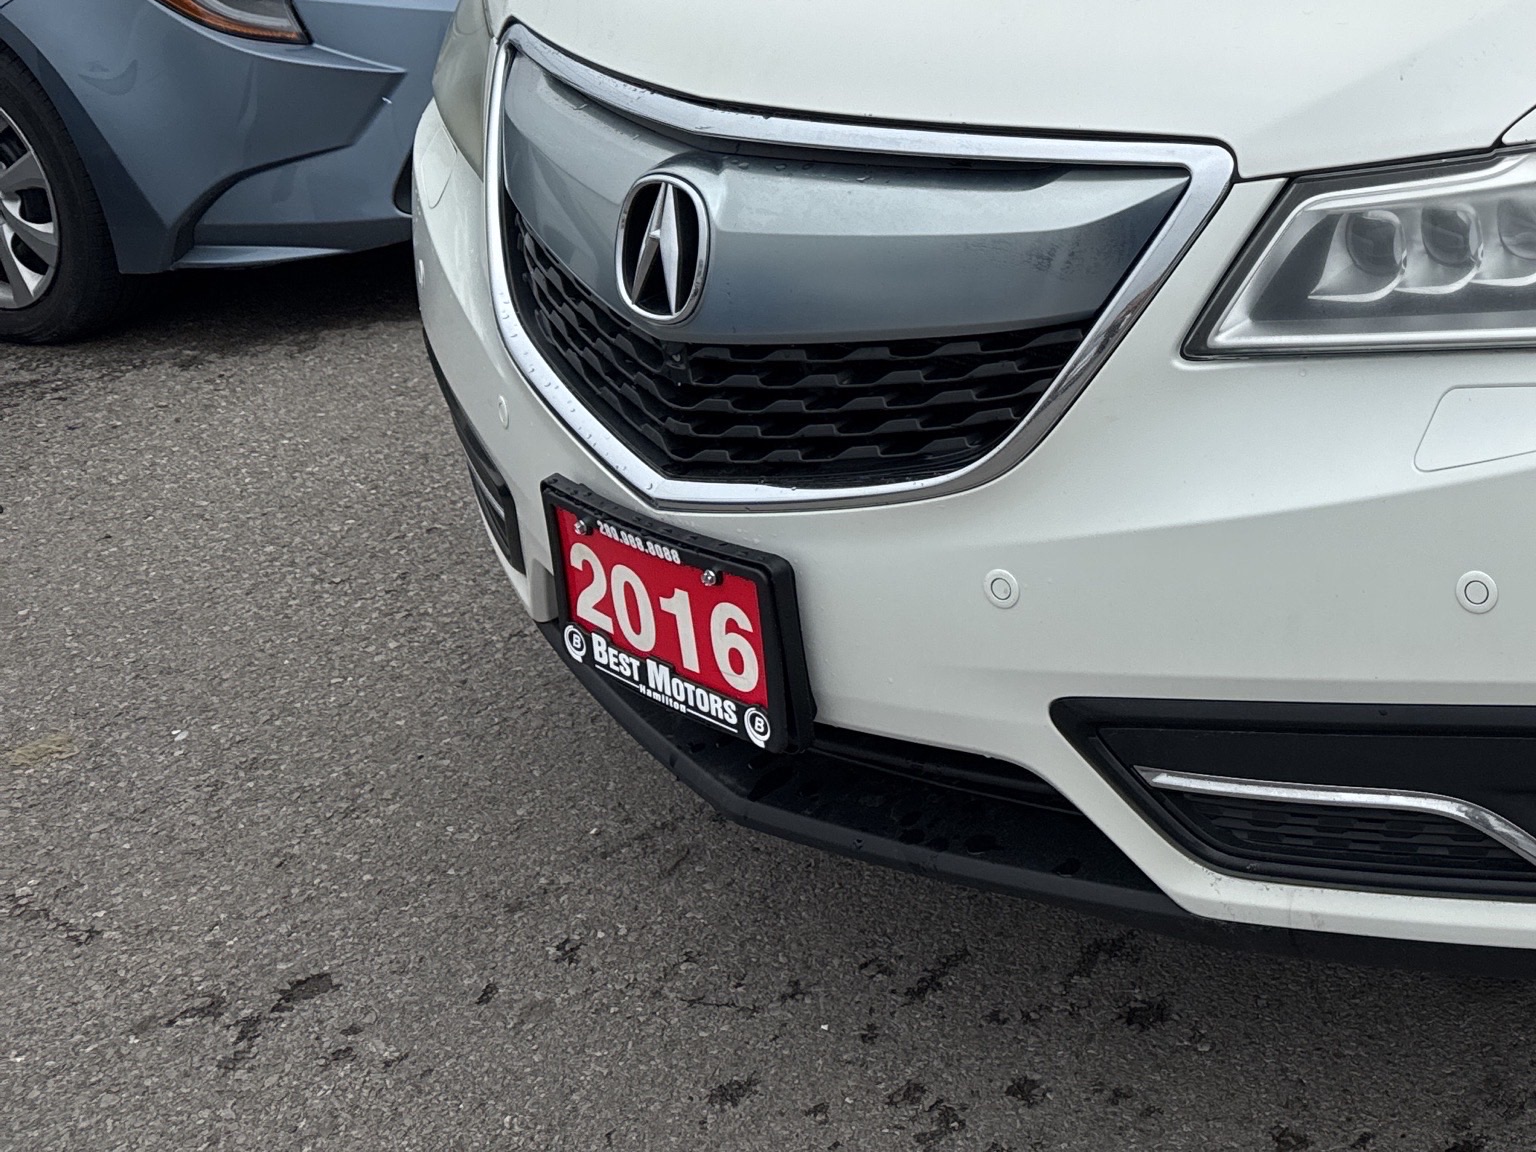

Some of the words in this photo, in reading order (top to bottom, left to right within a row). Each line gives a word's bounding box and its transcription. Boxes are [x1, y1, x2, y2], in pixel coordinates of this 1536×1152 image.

[569, 542, 760, 693] 2016
[591, 632, 641, 682] BEST
[646, 659, 738, 725] MOTORS
[639, 684, 687, 714] Hamilton
